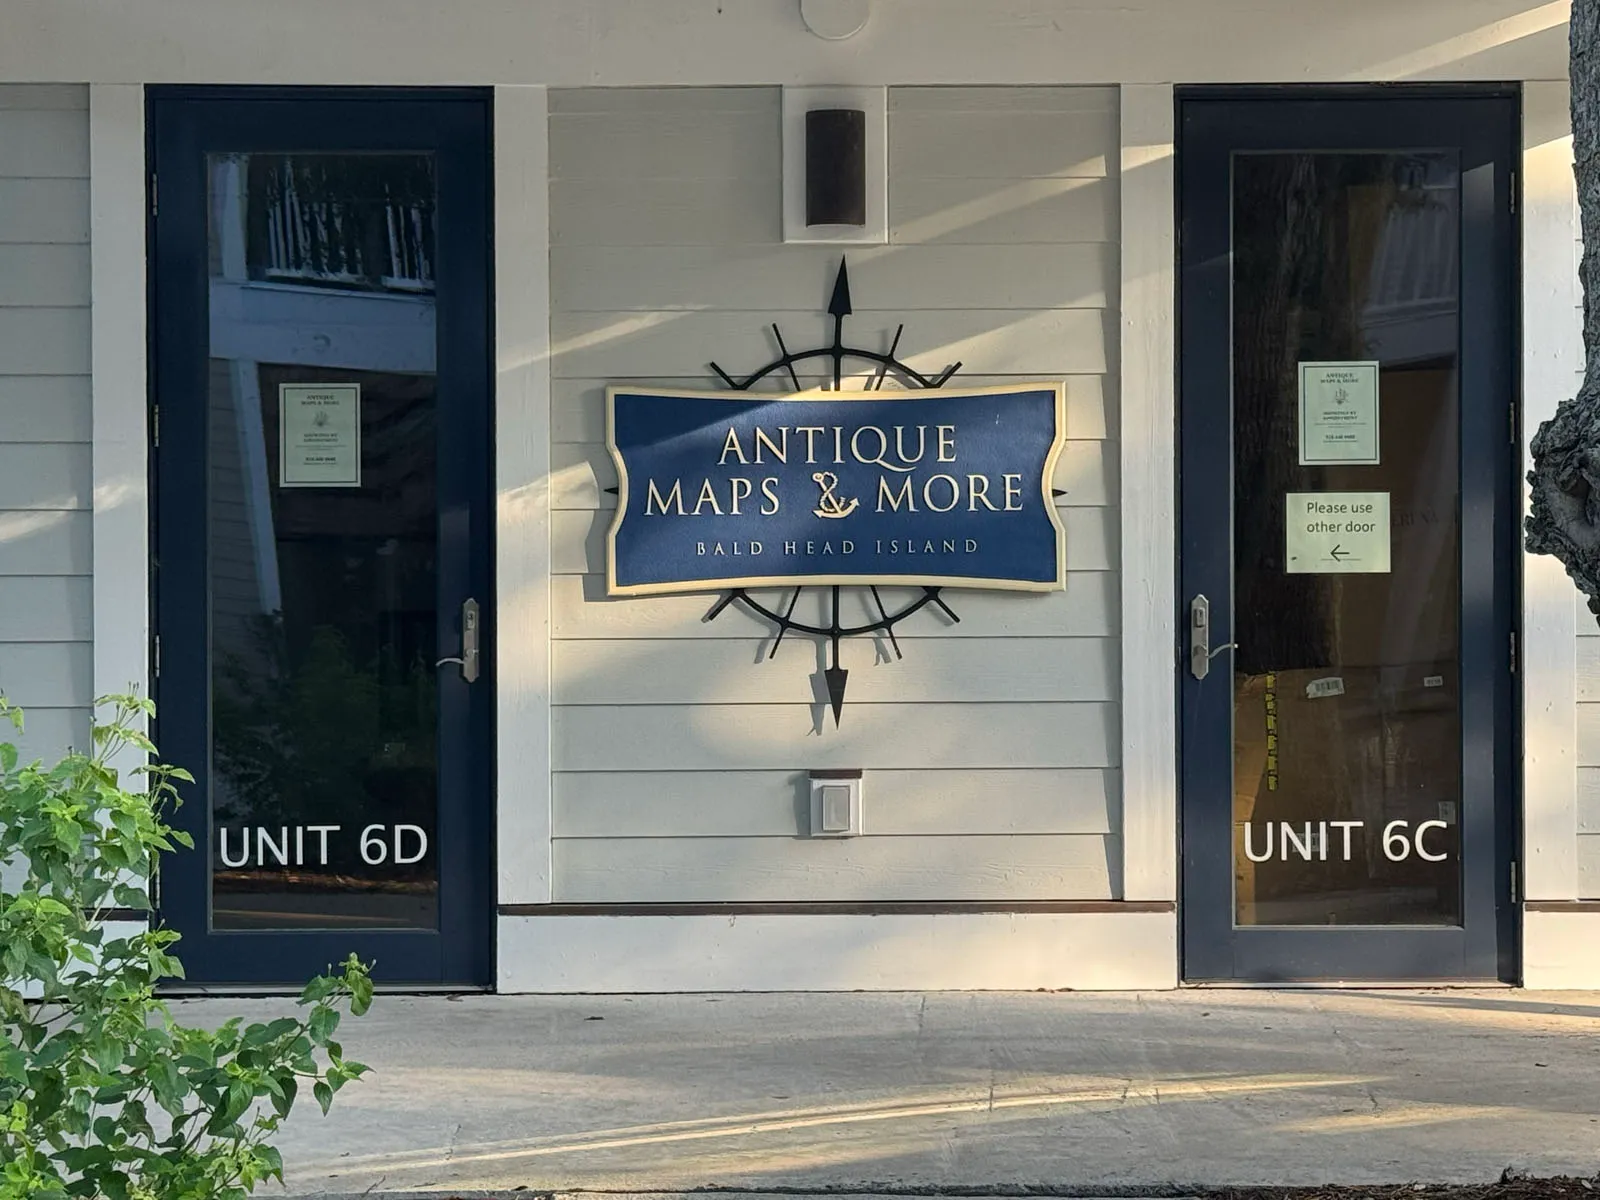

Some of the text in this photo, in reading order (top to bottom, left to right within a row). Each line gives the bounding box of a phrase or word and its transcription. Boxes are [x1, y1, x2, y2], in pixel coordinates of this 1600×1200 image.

[717, 424, 957, 472] ANTIQUE
[643, 476, 781, 516] MAPS
[875, 473, 1024, 513] MORE
[1307, 502, 1373, 514] Please use
[696, 539, 979, 556] BALD HEAD ISLAND
[1306, 521, 1376, 533] other door
[220, 824, 428, 867] UNIT 6D
[1244, 820, 1448, 862] UNIT 6C
